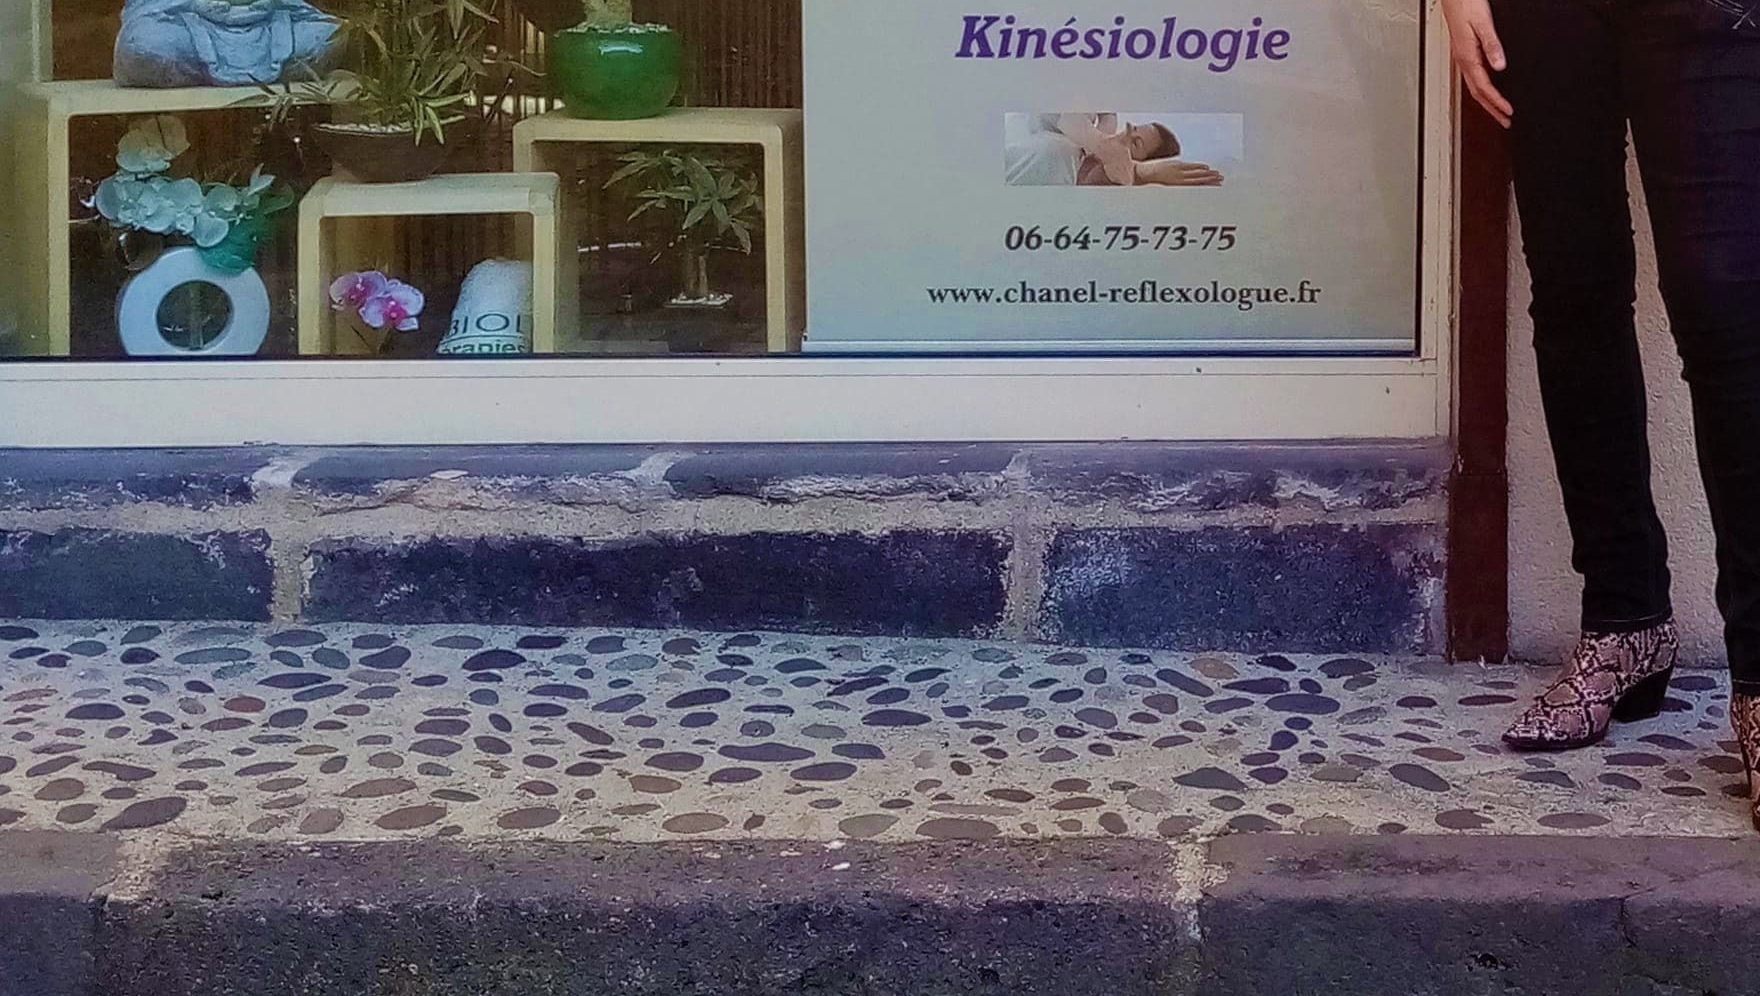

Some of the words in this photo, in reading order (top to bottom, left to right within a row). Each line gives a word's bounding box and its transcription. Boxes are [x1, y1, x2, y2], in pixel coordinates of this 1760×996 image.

[954, 15, 1291, 72] Kinésiologie
[1004, 225, 1237, 251] 06-64-75-73-75
[926, 281, 1322, 312] www.chanel-reflexologue.fr
